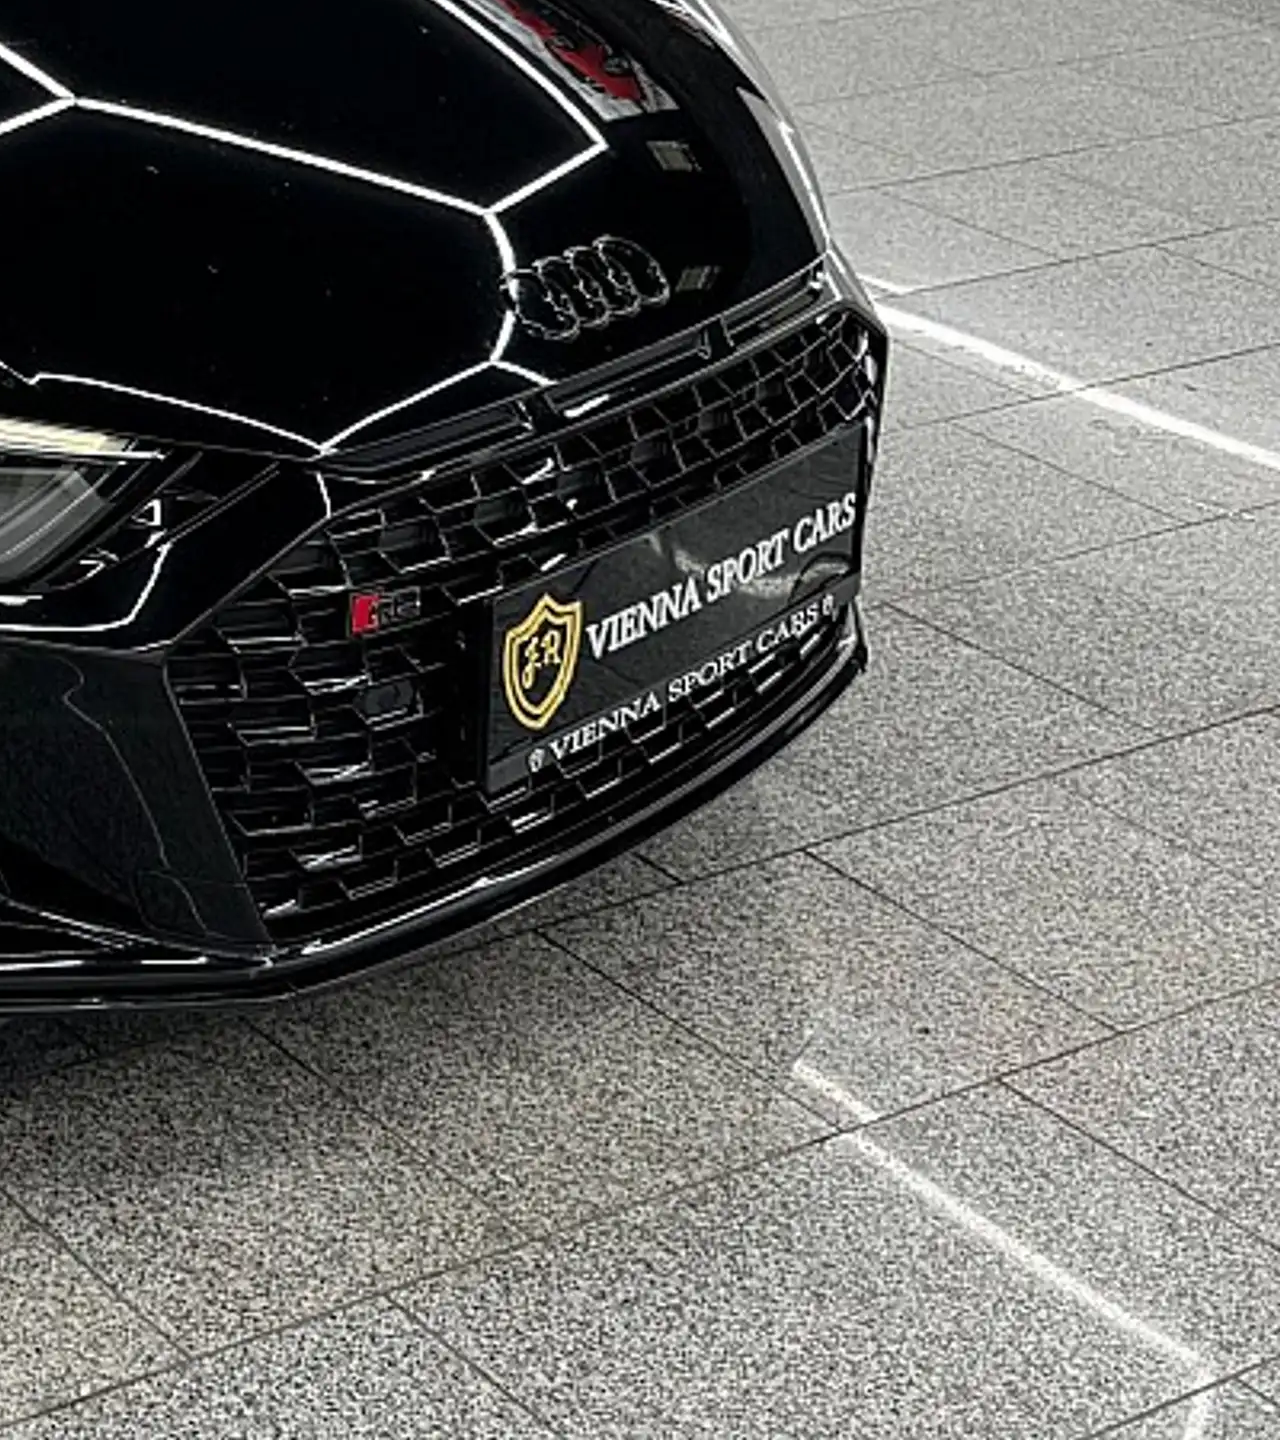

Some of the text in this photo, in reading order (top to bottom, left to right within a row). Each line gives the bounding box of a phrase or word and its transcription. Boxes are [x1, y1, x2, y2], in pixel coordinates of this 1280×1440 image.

[584, 491, 858, 660] VIENNA SPORT CARS
[547, 601, 820, 761] VIENNA SPORT CARS
